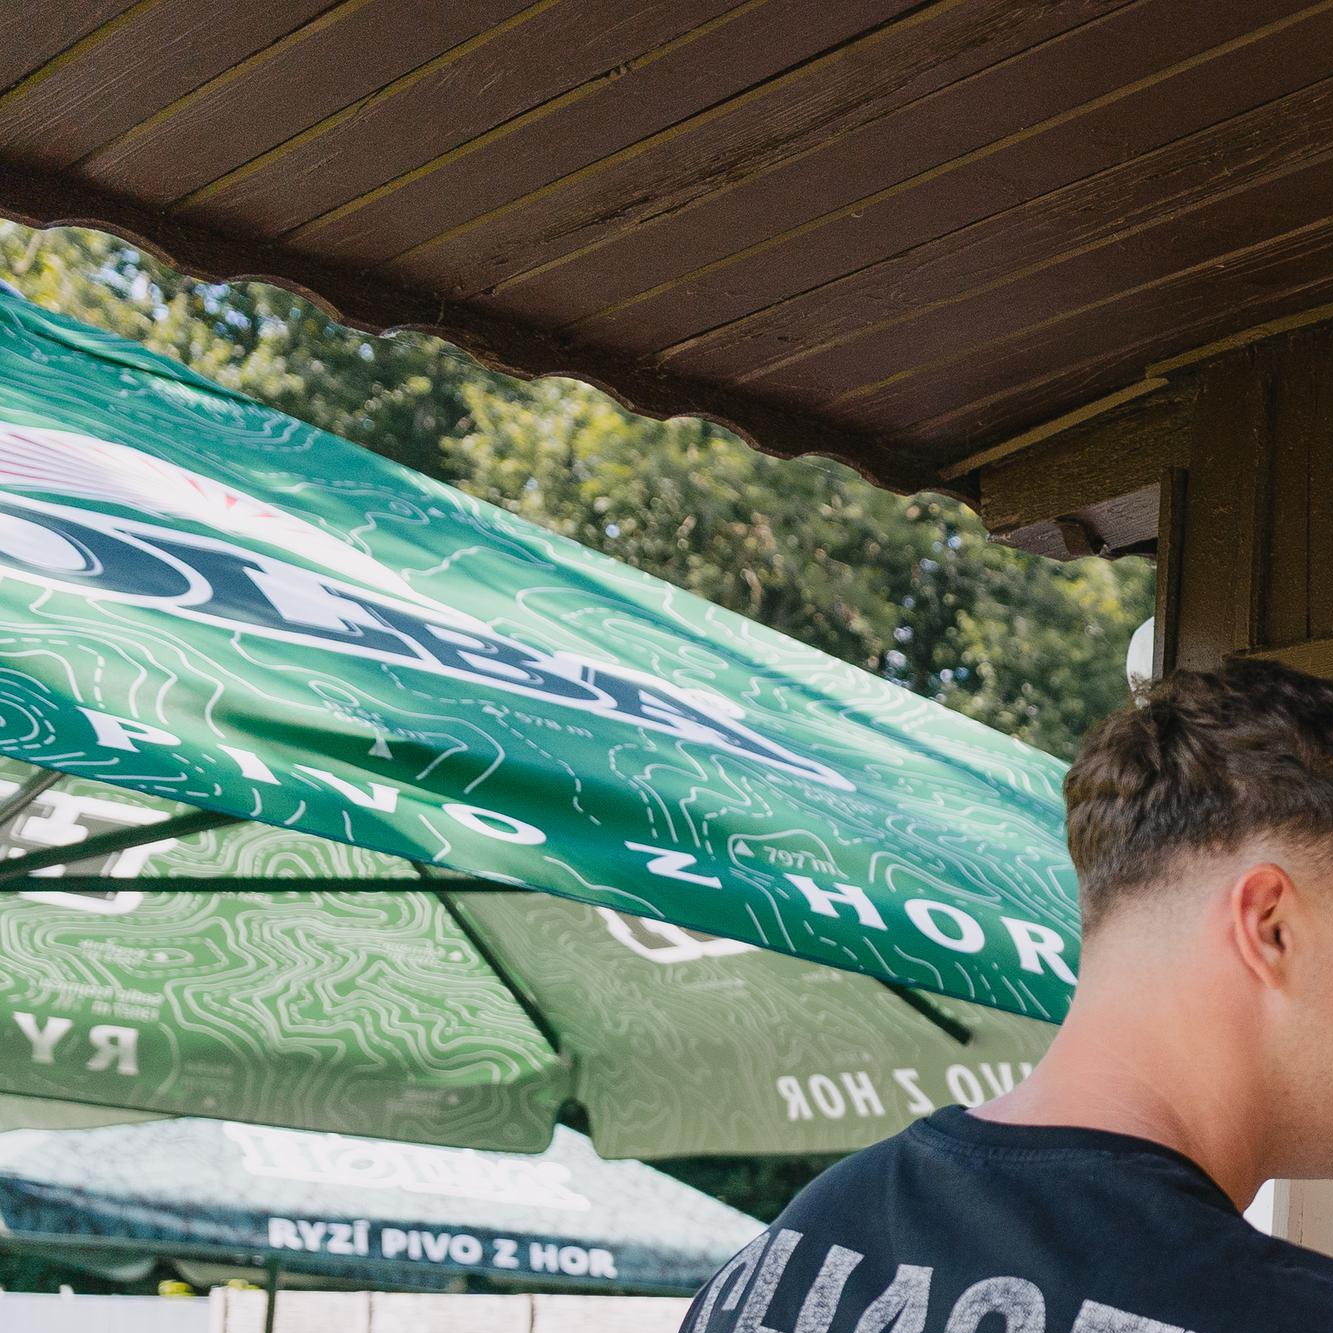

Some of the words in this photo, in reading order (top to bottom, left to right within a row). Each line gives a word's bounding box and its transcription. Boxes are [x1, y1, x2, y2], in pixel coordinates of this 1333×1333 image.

[76, 706, 548, 846] PIVO
[625, 840, 723, 889] Z
[783, 872, 1078, 986] HOR
[380, 1228, 484, 1267] PIVO
[491, 1238, 520, 1271] Z
[528, 1242, 618, 1280] HOR
